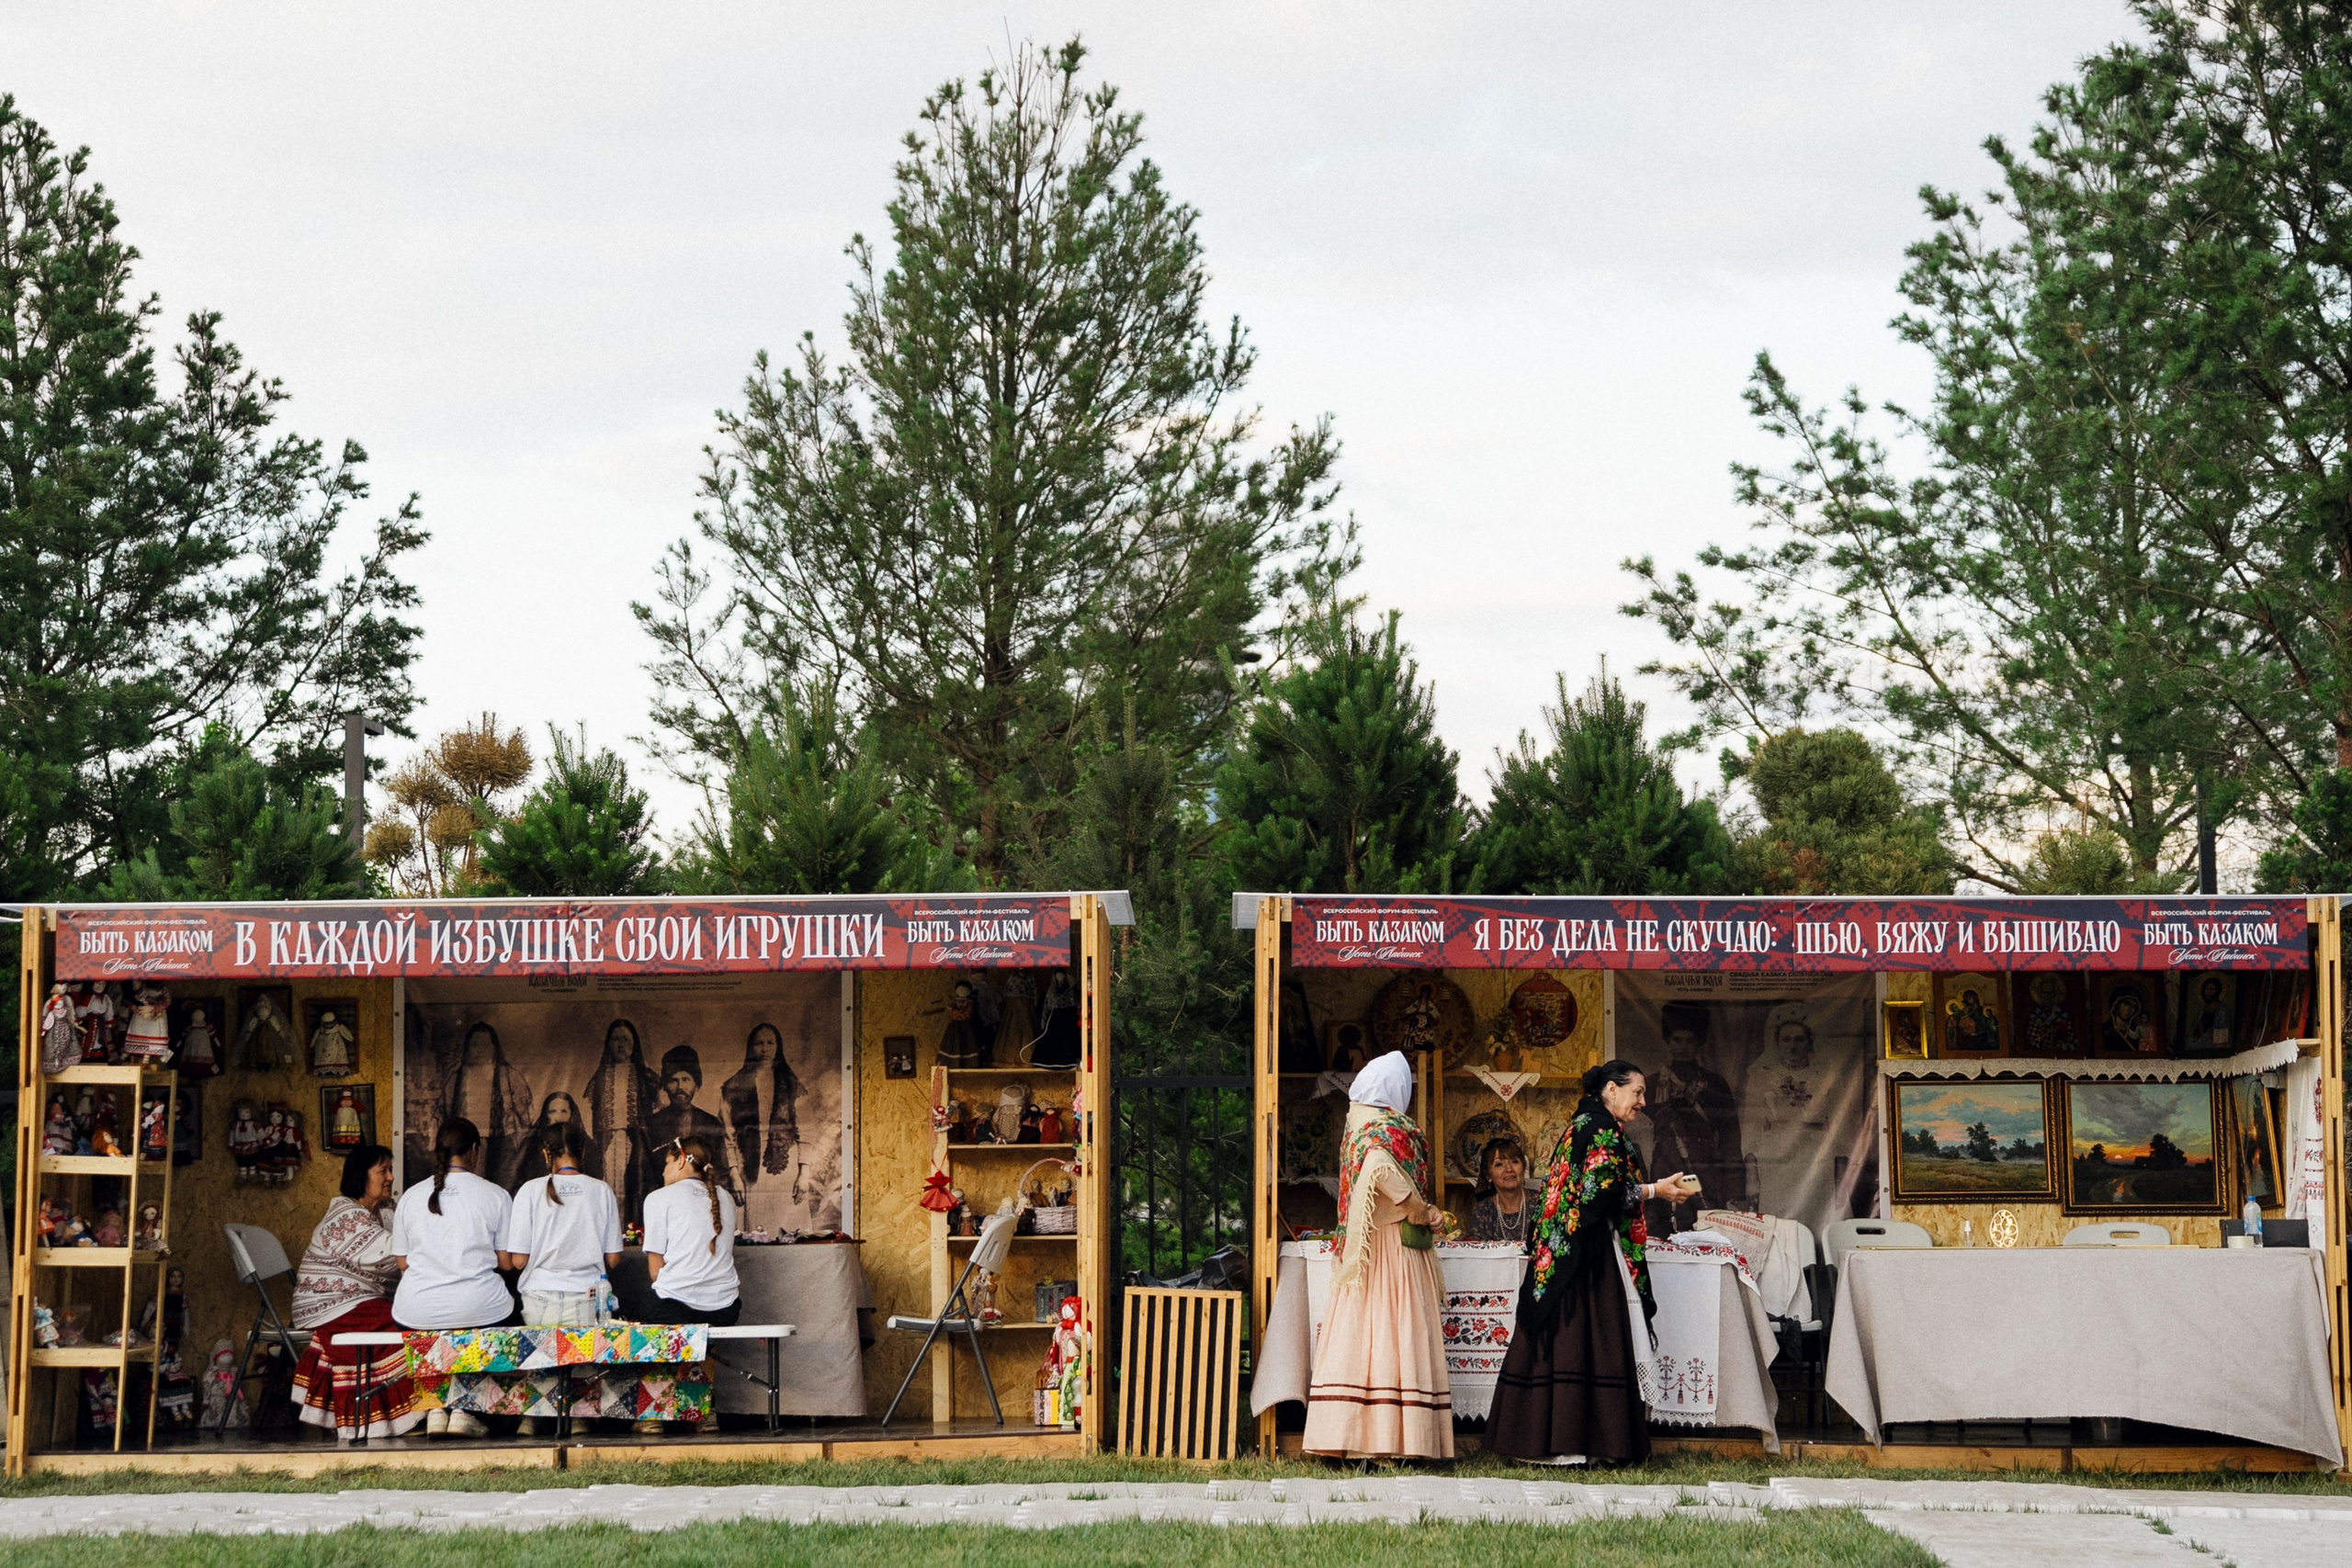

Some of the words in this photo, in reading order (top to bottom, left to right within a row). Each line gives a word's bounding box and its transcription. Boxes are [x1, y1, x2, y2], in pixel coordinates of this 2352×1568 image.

[80, 931, 130, 954] БЫТЬ
[134, 930, 214, 956] КАЗАКОМ
[234, 921, 256, 966] В
[268, 912, 417, 976] КАЖДОЙ
[429, 919, 605, 964] ИЗБУШКЕ
[616, 916, 704, 963] СВОИ
[715, 913, 886, 961] ИГРУШКИ
[907, 920, 955, 943] БЫТЬ
[959, 919, 1035, 945] КАЗАКОМ
[1316, 920, 1363, 943] БЫТЬ
[1368, 920, 1445, 947] КАЗАКОМ
[1473, 919, 1490, 953] Я
[1498, 919, 1544, 952] БЕЗ
[1551, 919, 1619, 958] ДЕЛА
[1625, 919, 1659, 953] НЕ
[1667, 919, 1777, 953] СКУЧАЮ:
[1796, 922, 1868, 958] ШЬЮ,
[1875, 921, 1950, 953] ВЯЖУ
[1956, 920, 1975, 953] И
[1983, 919, 2120, 953] ВЫШИВАЮ
[2143, 923, 2193, 945] БЫТЬ
[2198, 922, 2278, 949] КАЗАКОМ
[102, 957, 192, 976] Усть-Лабинск
[929, 946, 1016, 964] Усть-Лабинск
[1337, 945, 1424, 963] Усть-Лабинск
[2167, 947, 2257, 964] Усть-Лабинск
[1664, 975, 1701, 987] КАЗАЧЬЯ
[1702, 975, 1723, 987] ВОЛЯ
